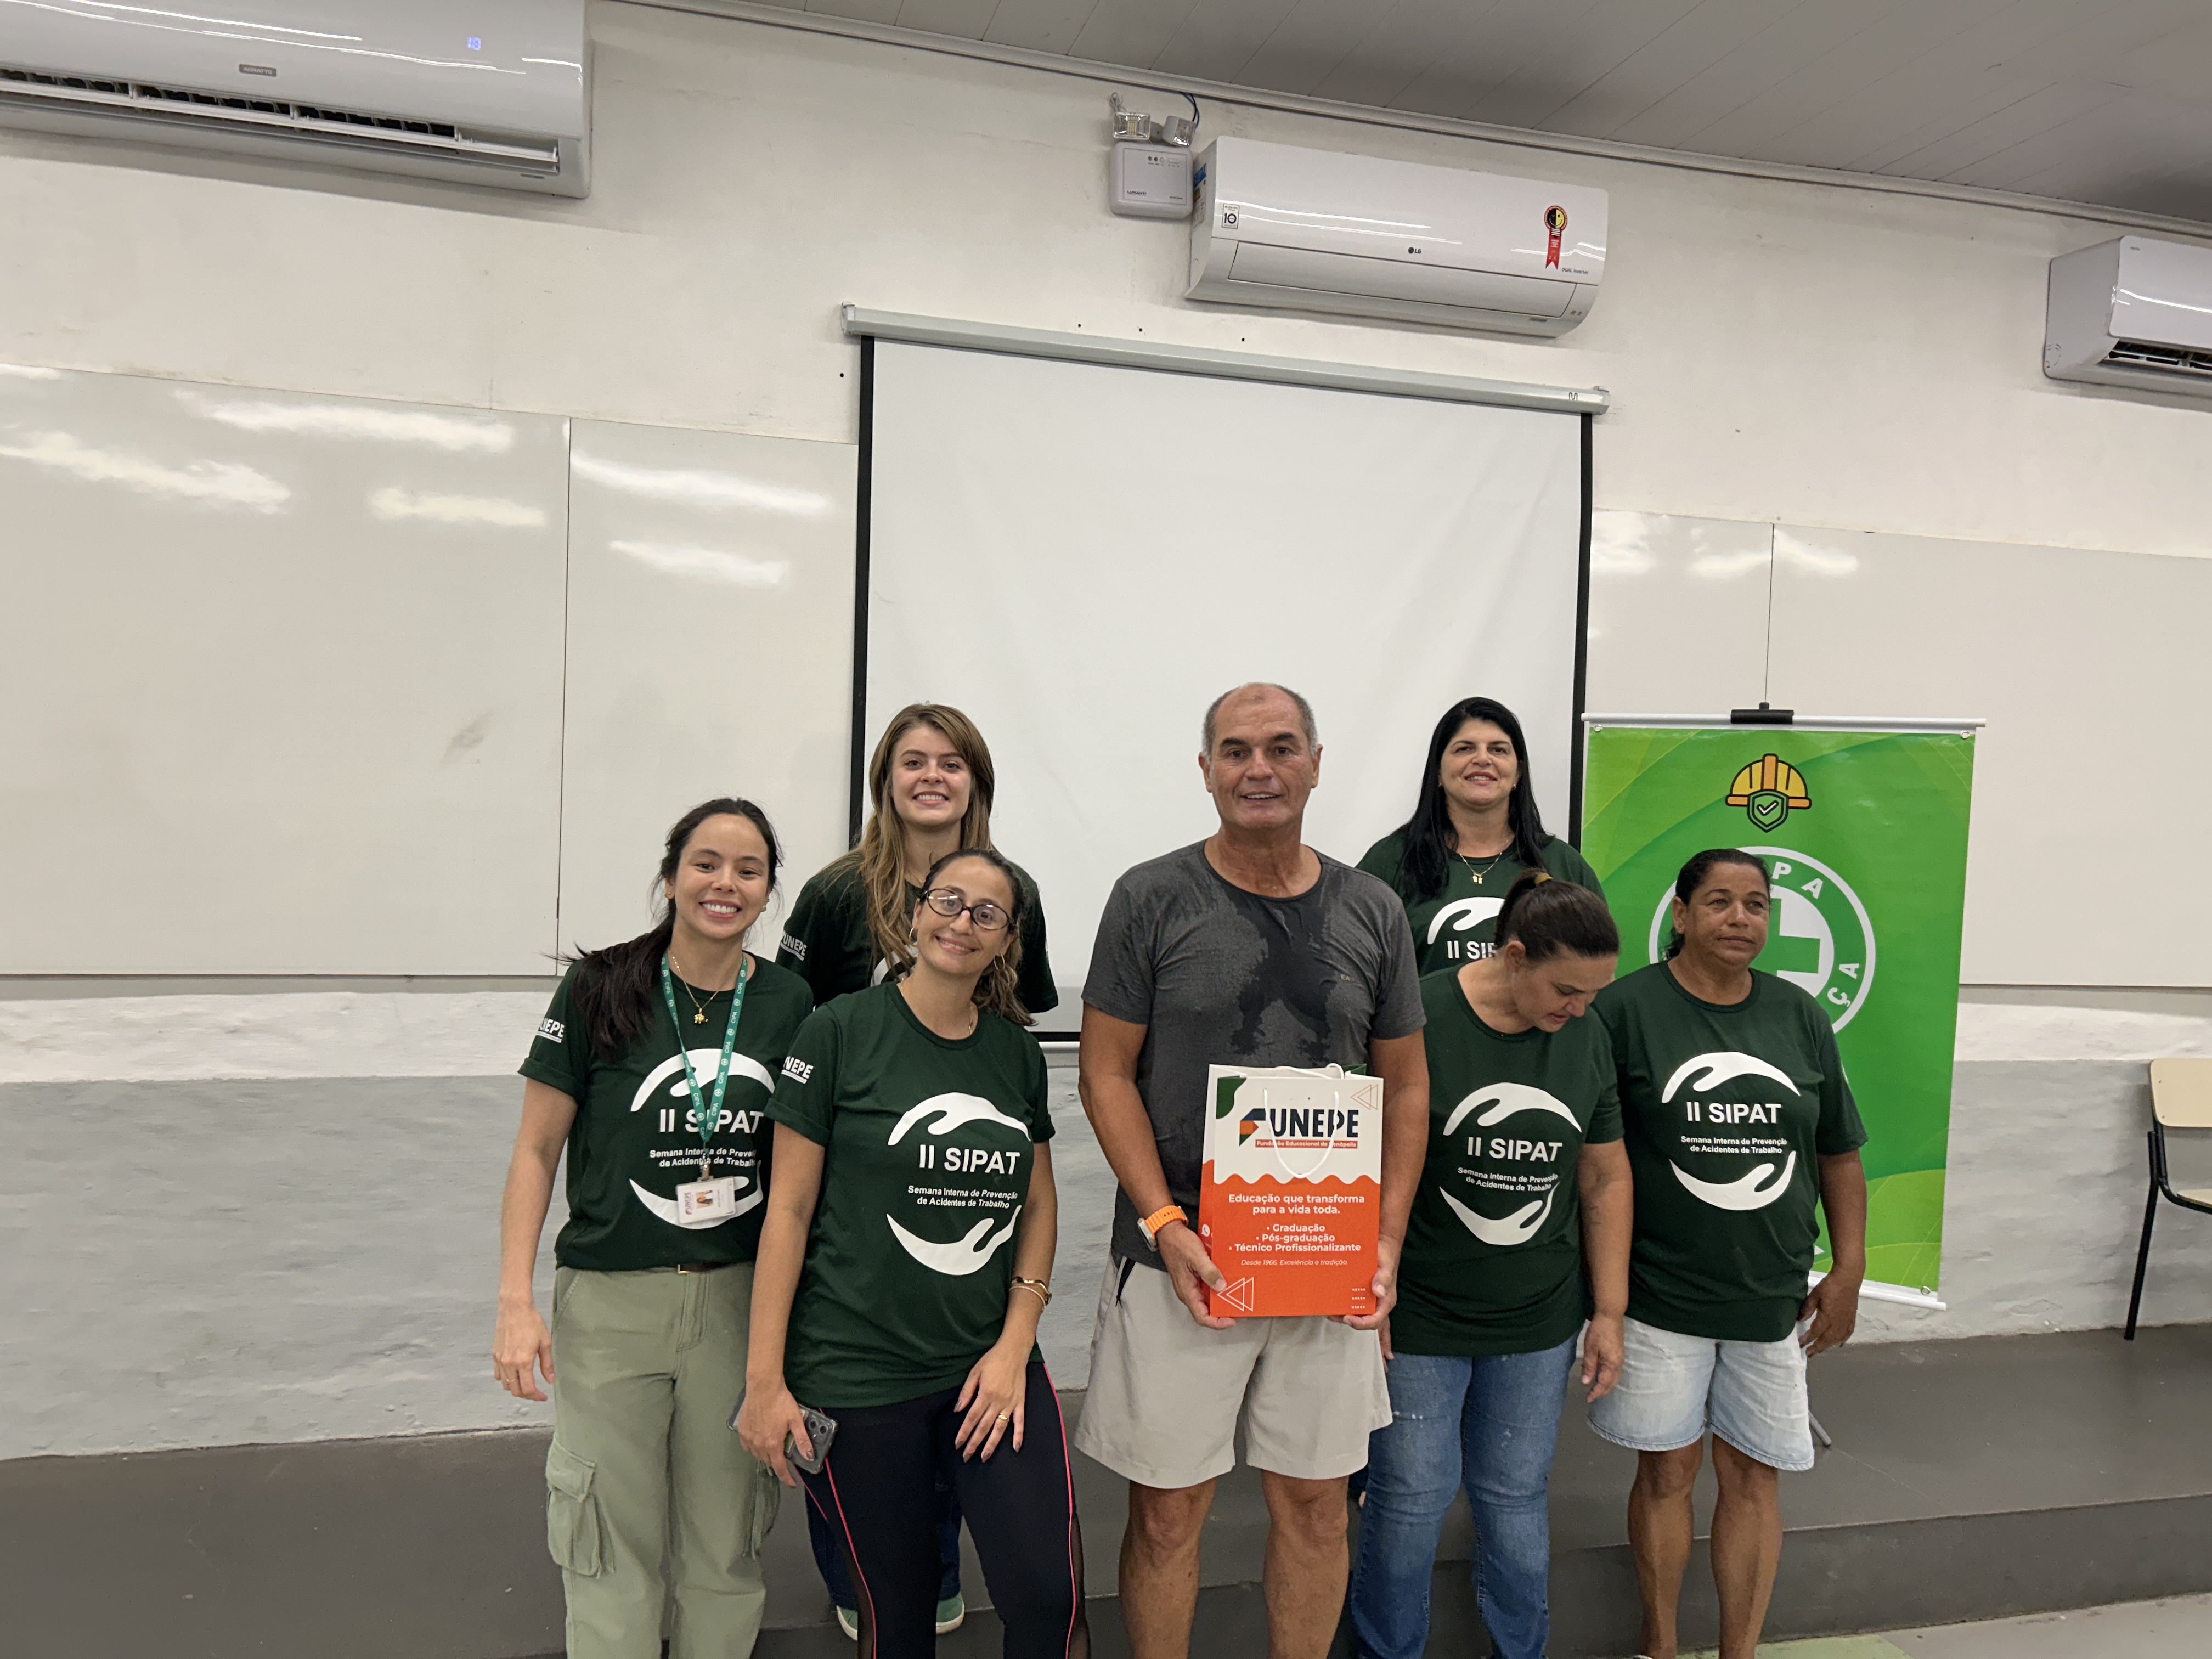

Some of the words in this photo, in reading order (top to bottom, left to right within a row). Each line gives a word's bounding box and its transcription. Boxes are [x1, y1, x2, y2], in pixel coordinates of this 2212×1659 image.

[1224, 213, 1237, 224] 10
[1686, 1101, 1700, 1121] II
[1709, 1102, 1781, 1124] SIPAT
[685, 1109, 764, 1133] SPAT
[1680, 1135, 1712, 1144] Semana
[1752, 1138, 1787, 1147] Prevenção
[650, 1149, 683, 1158] Semana
[1467, 1136, 1482, 1156] II
[1489, 1138, 1563, 1163] SIPAT
[1701, 1145, 1739, 1153] Acidentes
[919, 1144, 934, 1169] II
[944, 1147, 1020, 1175] SIPAT
[1458, 1167, 1488, 1179] Semana
[1489, 1172, 1516, 1182] Interna
[1476, 1180, 1514, 1191] Acidentes
[907, 1185, 942, 1195] Semana
[944, 1187, 969, 1197] Interna
[970, 1189, 980, 1197] de
[981, 1189, 1018, 1201] Prevenção
[1228, 1193, 1280, 1204] Educação
[1283, 1195, 1304, 1204] que
[1306, 1194, 1365, 1203] transforma
[917, 1197, 928, 1205] de
[929, 1197, 966, 1207] Acidentes
[967, 1199, 977, 1207] de
[978, 1199, 1010, 1209] Trabalho
[1252, 1206, 1276, 1215] para
[1288, 1205, 1311, 1214] vida
[1313, 1205, 1340, 1214] toda.
[1272, 1223, 1325, 1234] Graduação
[1262, 1233, 1335, 1244] Pós-graduação
[1234, 1243, 1272, 1251] Técnico
[1275, 1243, 1361, 1251] Profissionalizante
